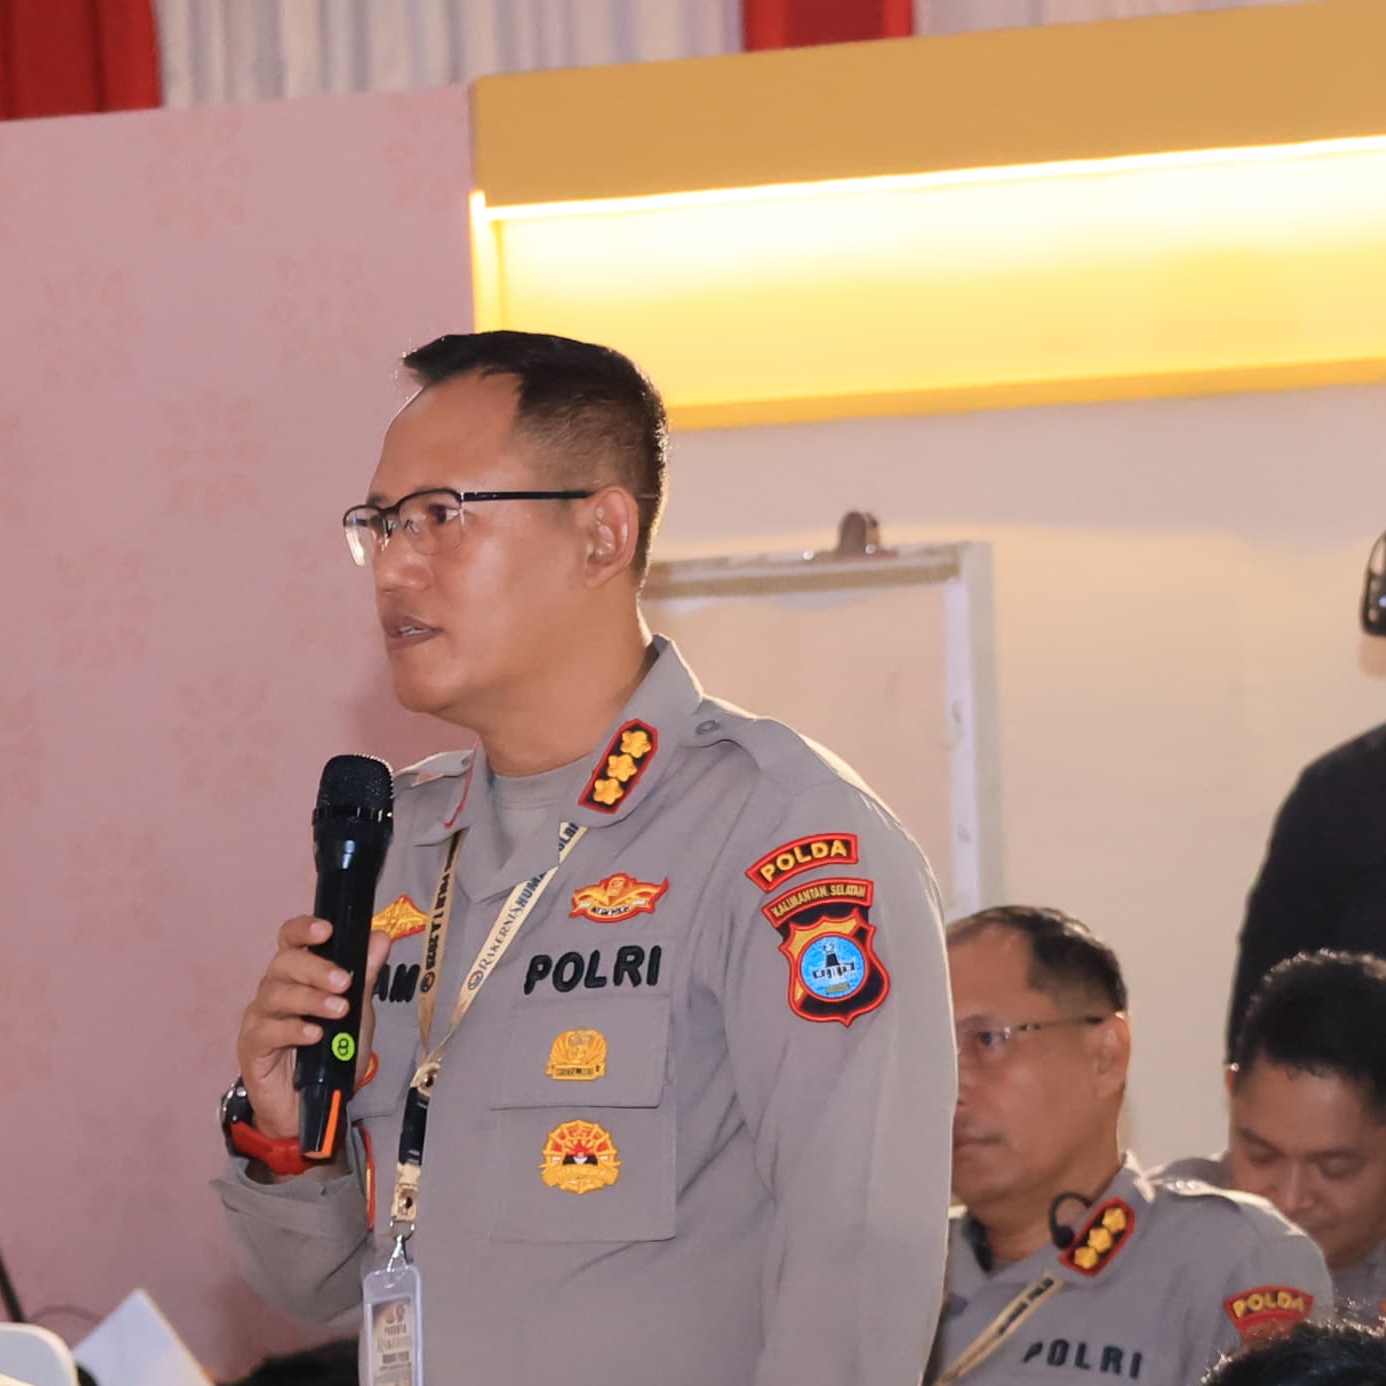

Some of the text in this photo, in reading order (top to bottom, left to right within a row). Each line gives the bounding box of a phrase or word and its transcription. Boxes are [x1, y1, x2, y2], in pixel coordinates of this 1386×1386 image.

[760, 839, 848, 883] POLDA
[524, 945, 662, 995] POLRI
[1232, 1290, 1306, 1318] POLDA
[1021, 1339, 1143, 1380] POLRI
